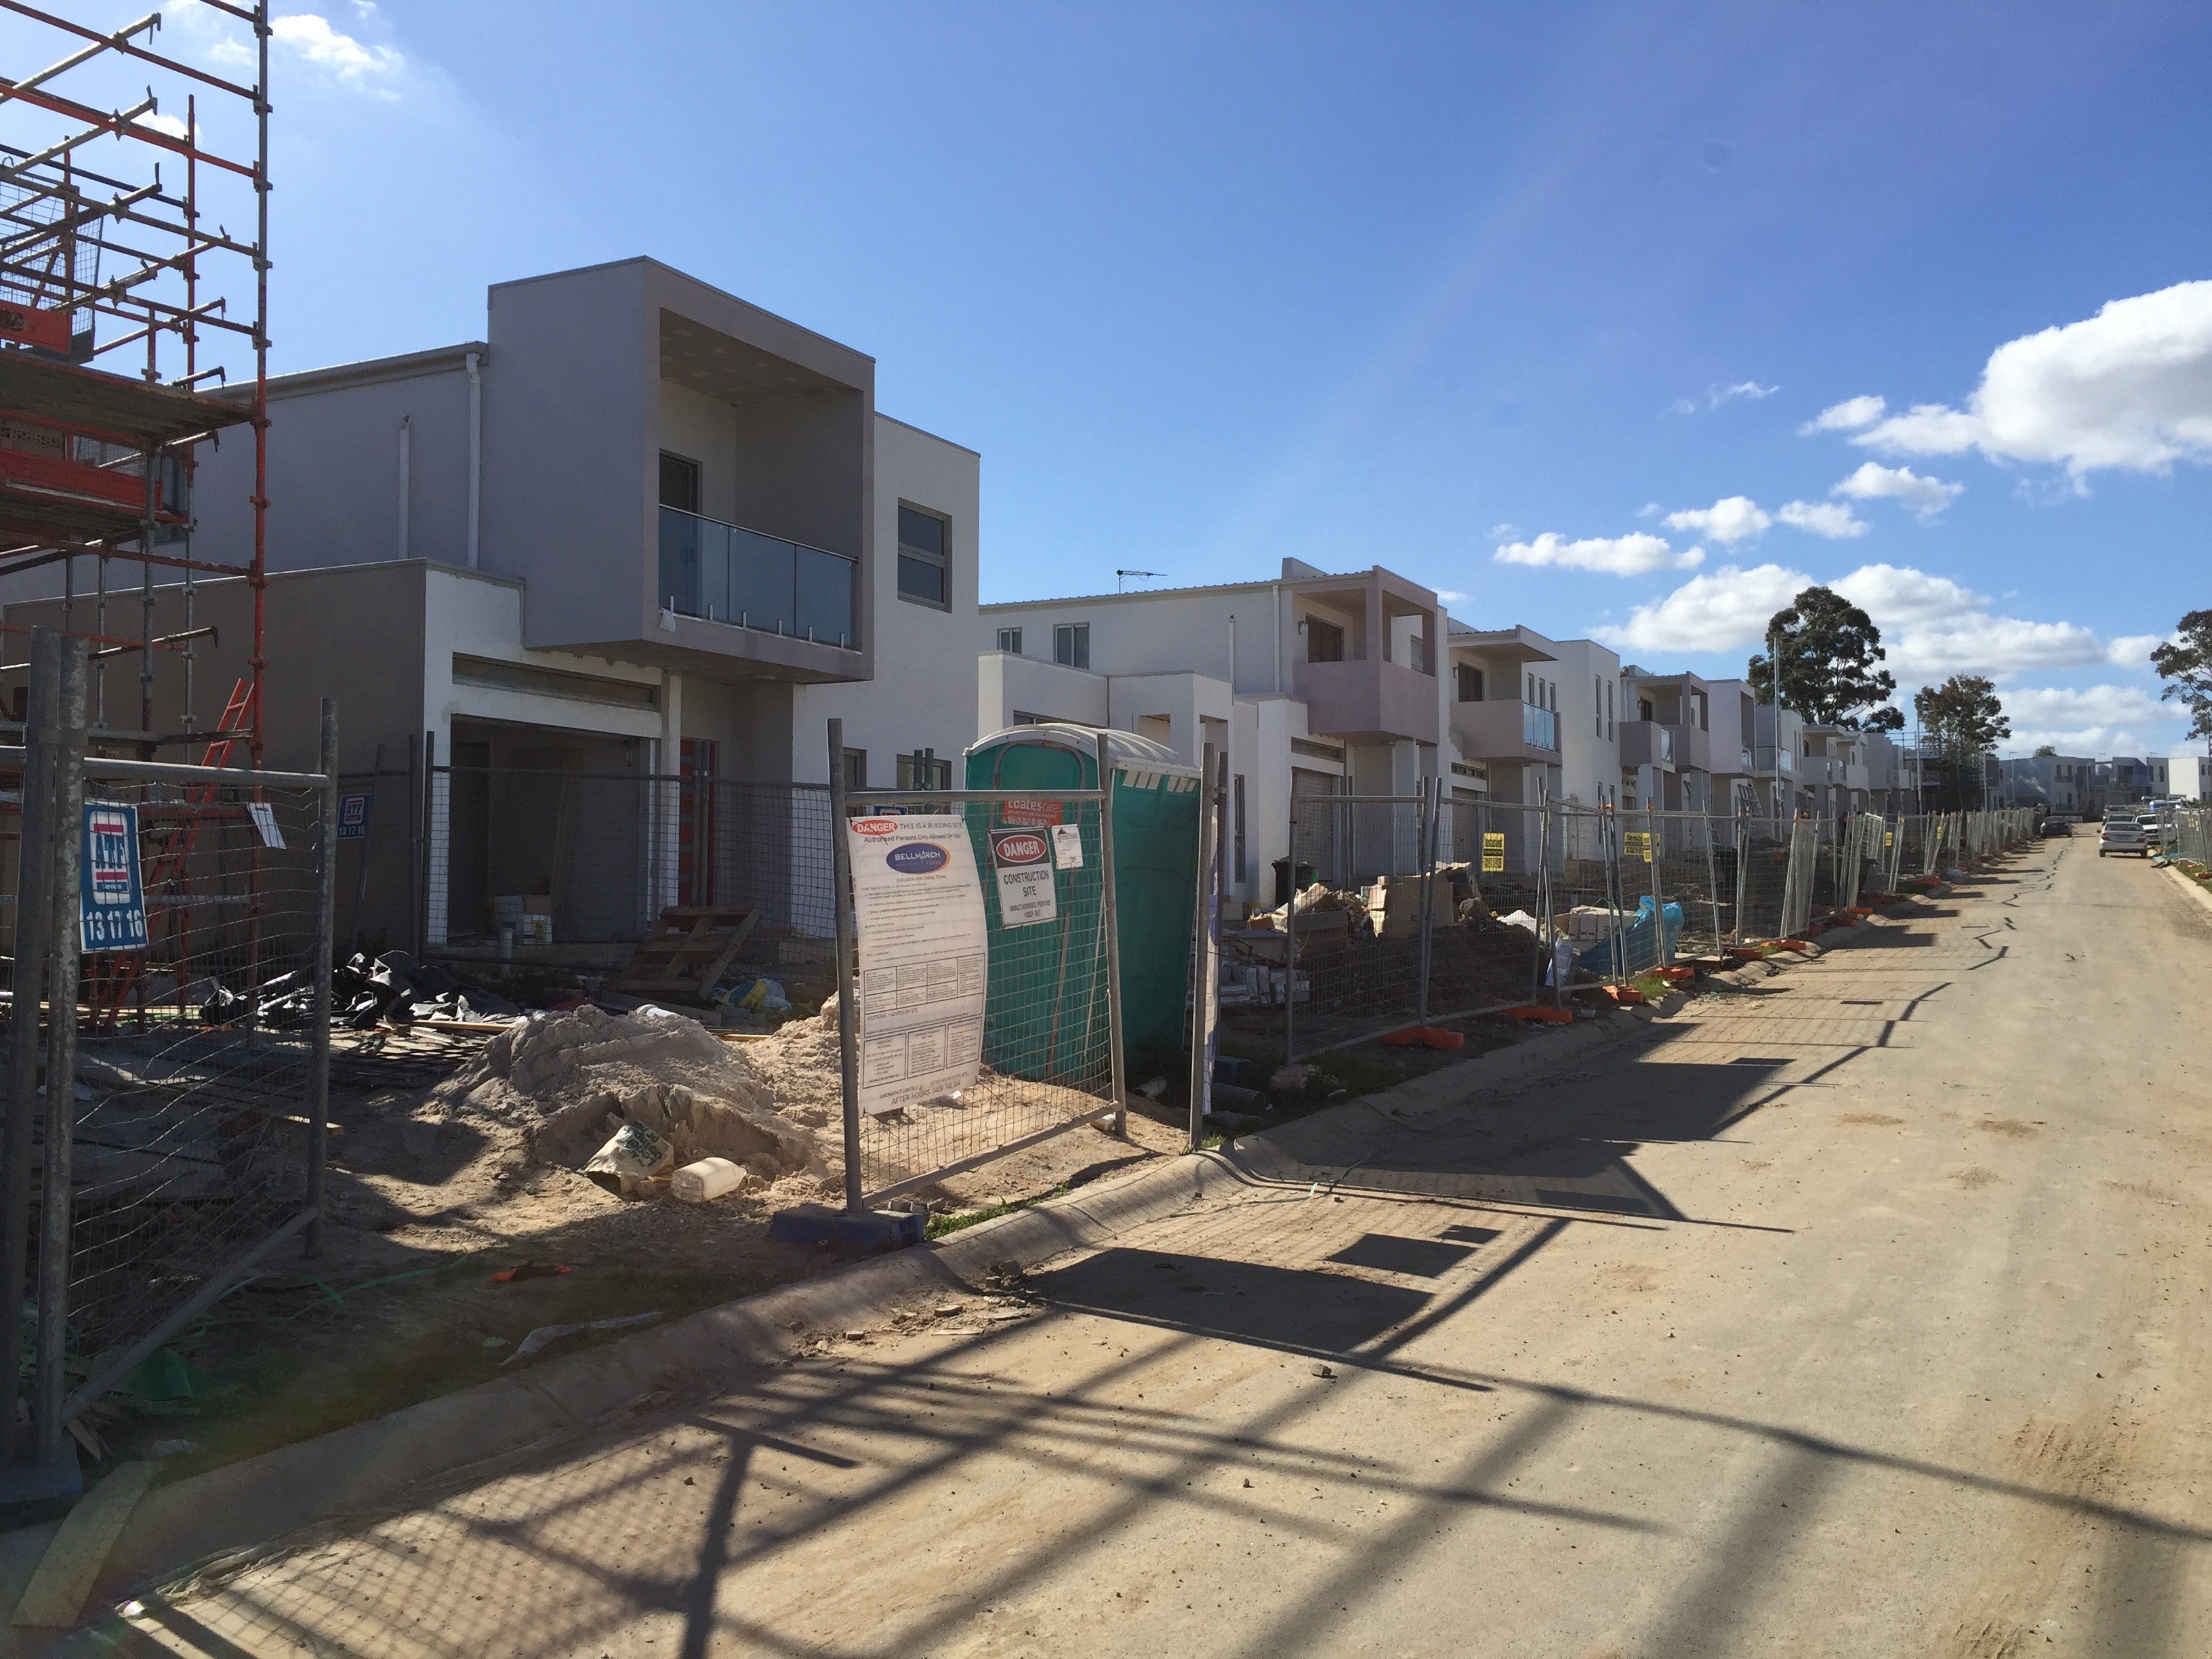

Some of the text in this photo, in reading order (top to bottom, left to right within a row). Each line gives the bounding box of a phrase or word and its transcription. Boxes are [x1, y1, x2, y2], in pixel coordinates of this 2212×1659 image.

[857, 822, 895, 833] DANGER
[95, 834, 127, 869] ATF
[1003, 840, 1040, 857] DANGER
[1003, 869, 1050, 885] CONSTRUCTION
[1023, 885, 1037, 897] SITE
[86, 909, 144, 941] 13 17 16
[891, 1094, 911, 1105] AFTER
[911, 1088, 931, 1100] HOURS
